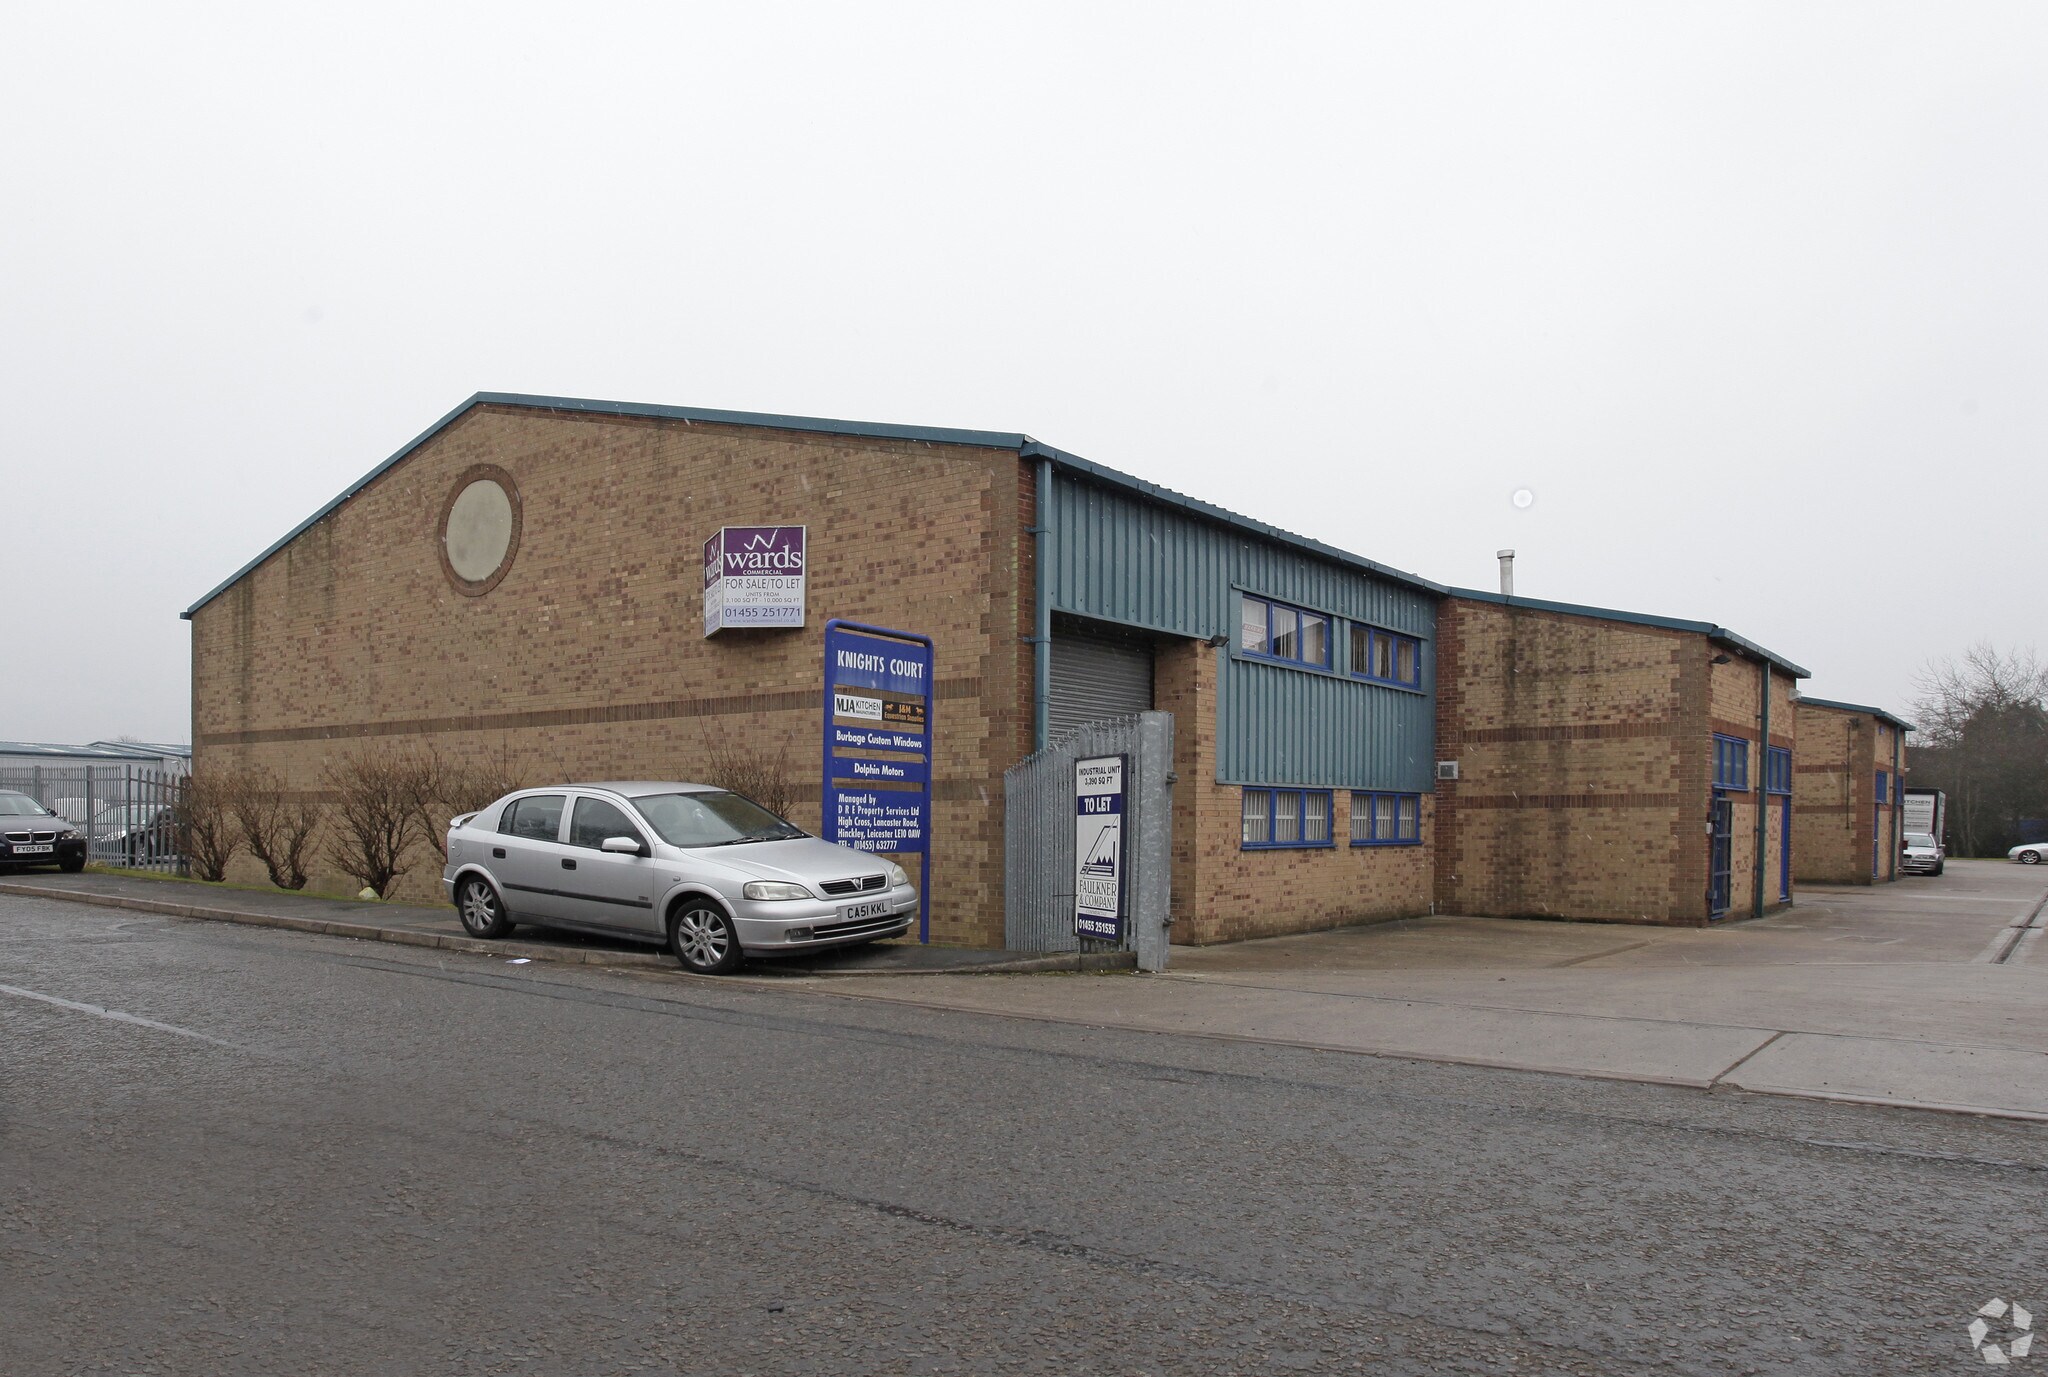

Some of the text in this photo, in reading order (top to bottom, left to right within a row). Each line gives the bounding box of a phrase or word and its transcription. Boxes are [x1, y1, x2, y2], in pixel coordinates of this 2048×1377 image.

[725, 545, 802, 569] wards
[725, 579, 743, 589] FOR
[746, 579, 783, 590] SALE/TO
[786, 579, 800, 589] LET
[725, 608, 800, 617] 01455 251771
[837, 650, 923, 678] KNIGHTS COURT
[836, 698, 880, 714] MJA KITCHEN
[836, 731, 922, 748] Burbage Custom Windows
[854, 763, 904, 776] Dolphin Motors
[1079, 767, 1106, 776] INDUSTRIAL
[1098, 776, 1106, 784] SQ
[1106, 776, 1113, 784] FT
[838, 794, 876, 806] Managed by
[1084, 797, 1111, 813] TO LET
[838, 805, 920, 817] D R E Property Services Ltd
[838, 816, 919, 828] High Cross, Lancaster Road,
[838, 828, 866, 840] Hinckley,
[867, 829, 894, 838] Leicester
[895, 829, 906, 838] LE10
[854, 840, 875, 852] (01455)
[876, 841, 897, 850] 632777
[1080, 880, 1117, 896] FAULKNER
[1079, 894, 1116, 909] & COMPANY
[847, 902, 887, 919] CA51 KKL
[1078, 919, 1116, 934] 01455 251535
